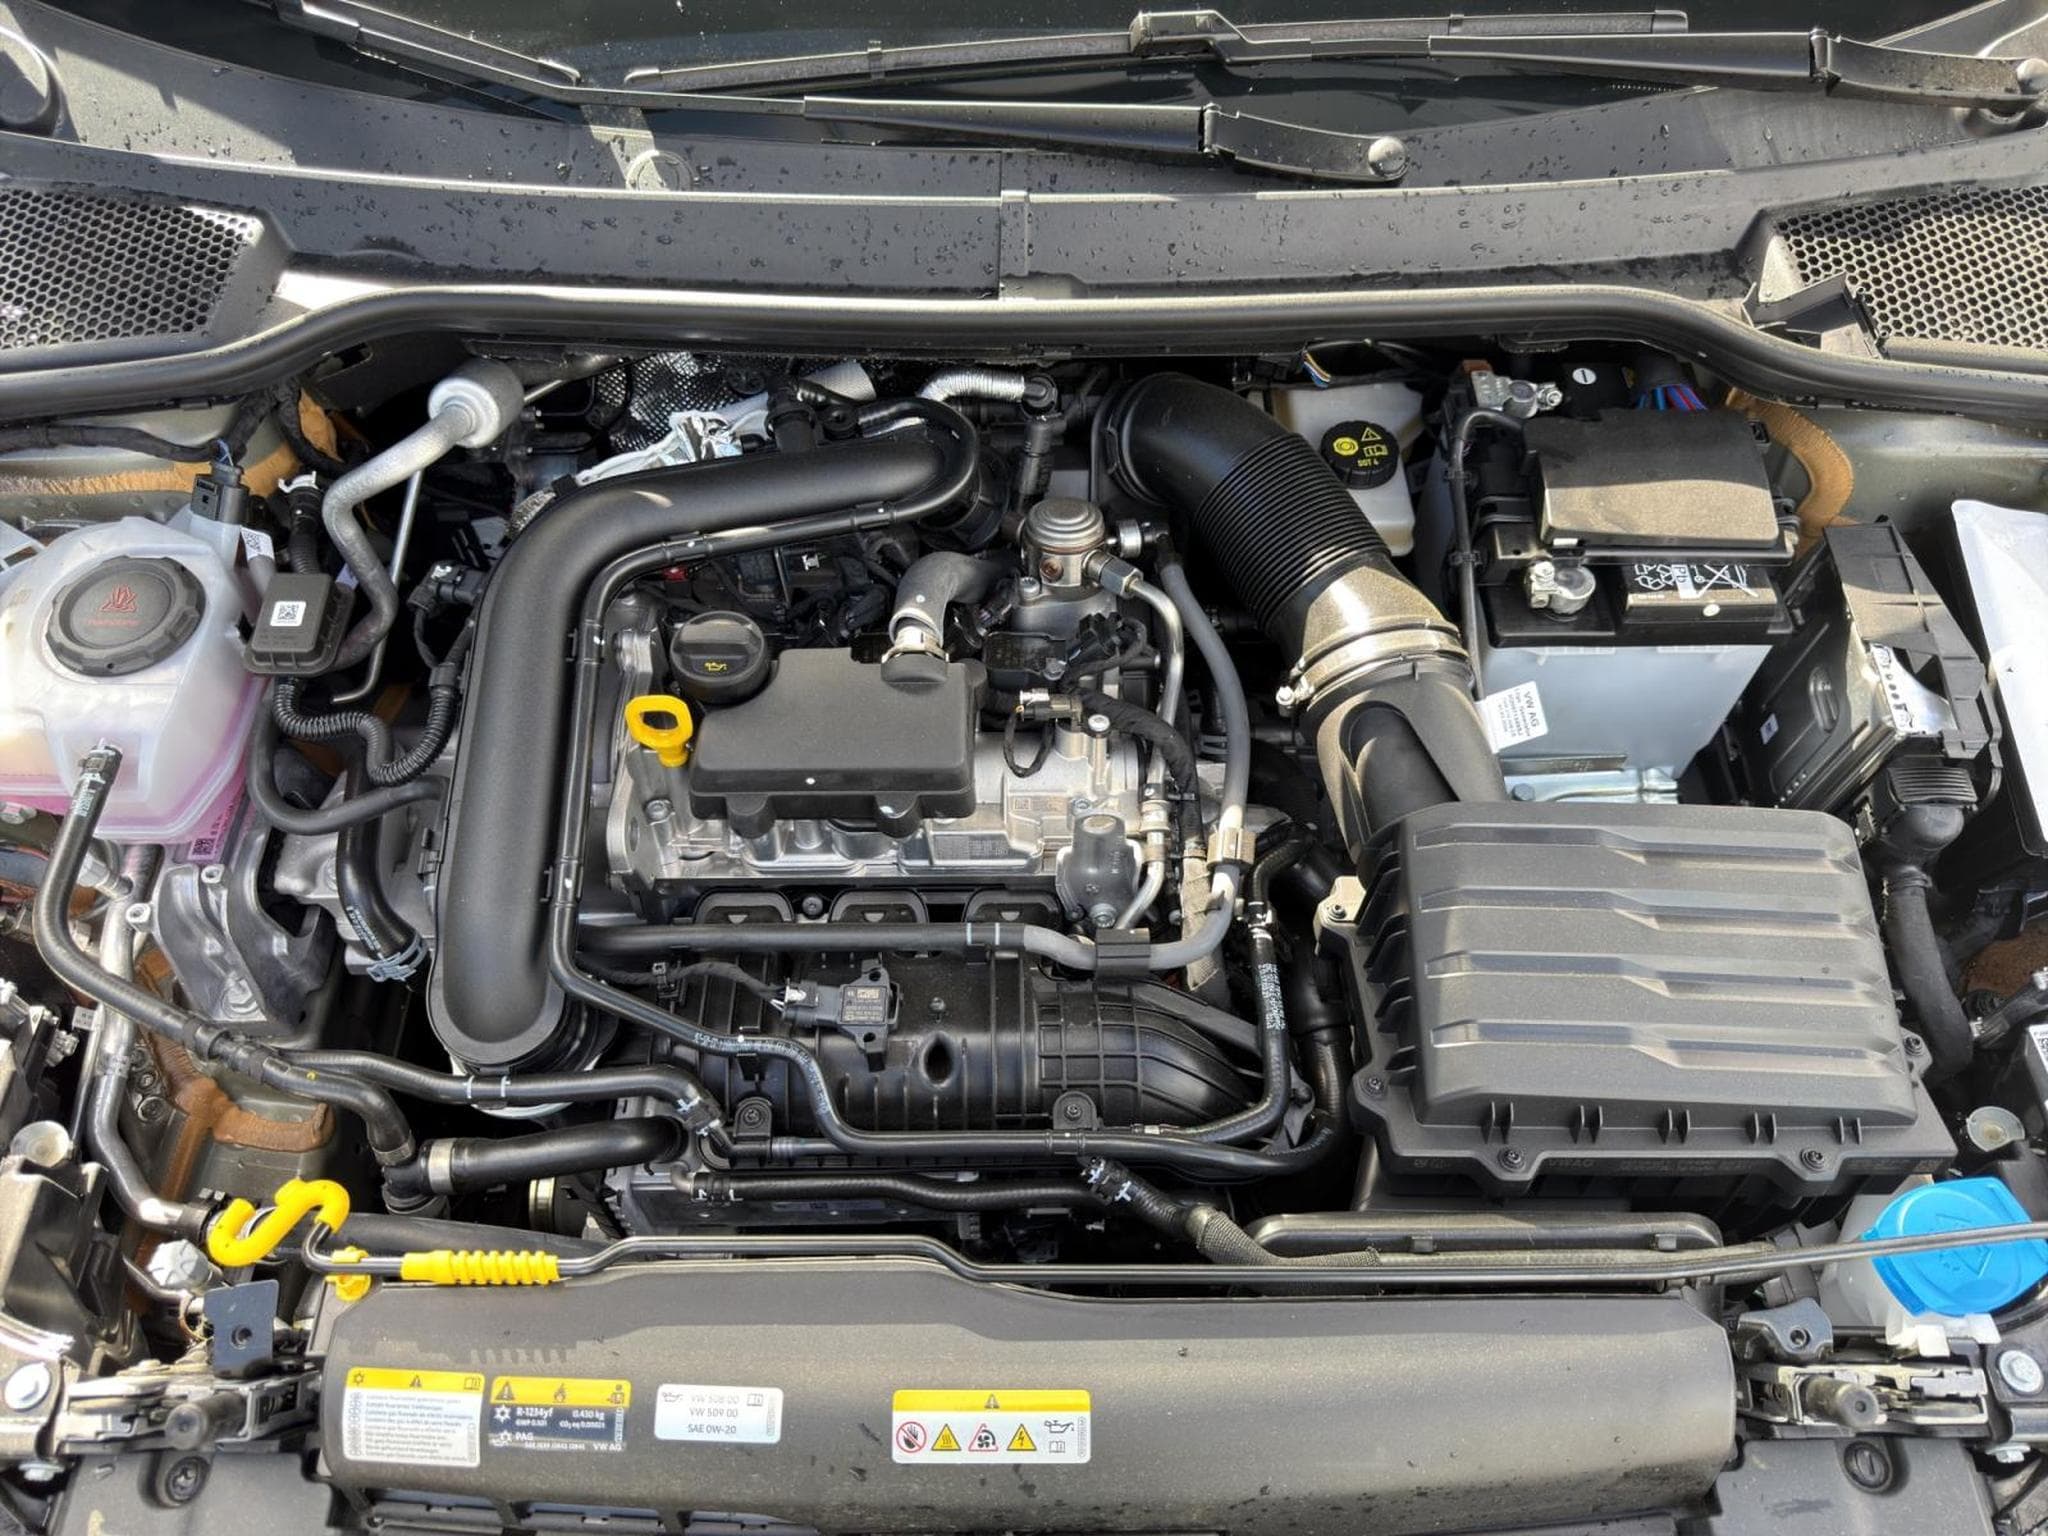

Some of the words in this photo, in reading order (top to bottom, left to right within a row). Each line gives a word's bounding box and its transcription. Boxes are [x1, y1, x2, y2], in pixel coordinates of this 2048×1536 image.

[1676, 566, 1687, 583] Pb
[1524, 691, 1535, 708] VW
[1529, 712, 1540, 727] AG
[690, 1394, 705, 1403] VW
[517, 1408, 553, 1419] R-1234yf
[595, 1411, 605, 1421] kg
[689, 1407, 706, 1416] VW
[707, 1408, 724, 1417] 509
[726, 1408, 739, 1417] 00
[687, 1424, 705, 1433] SAE
[706, 1425, 737, 1434] 0W-20
[515, 1431, 534, 1441] PAG
[593, 1443, 608, 1451] VW
[609, 1443, 622, 1452] AG
